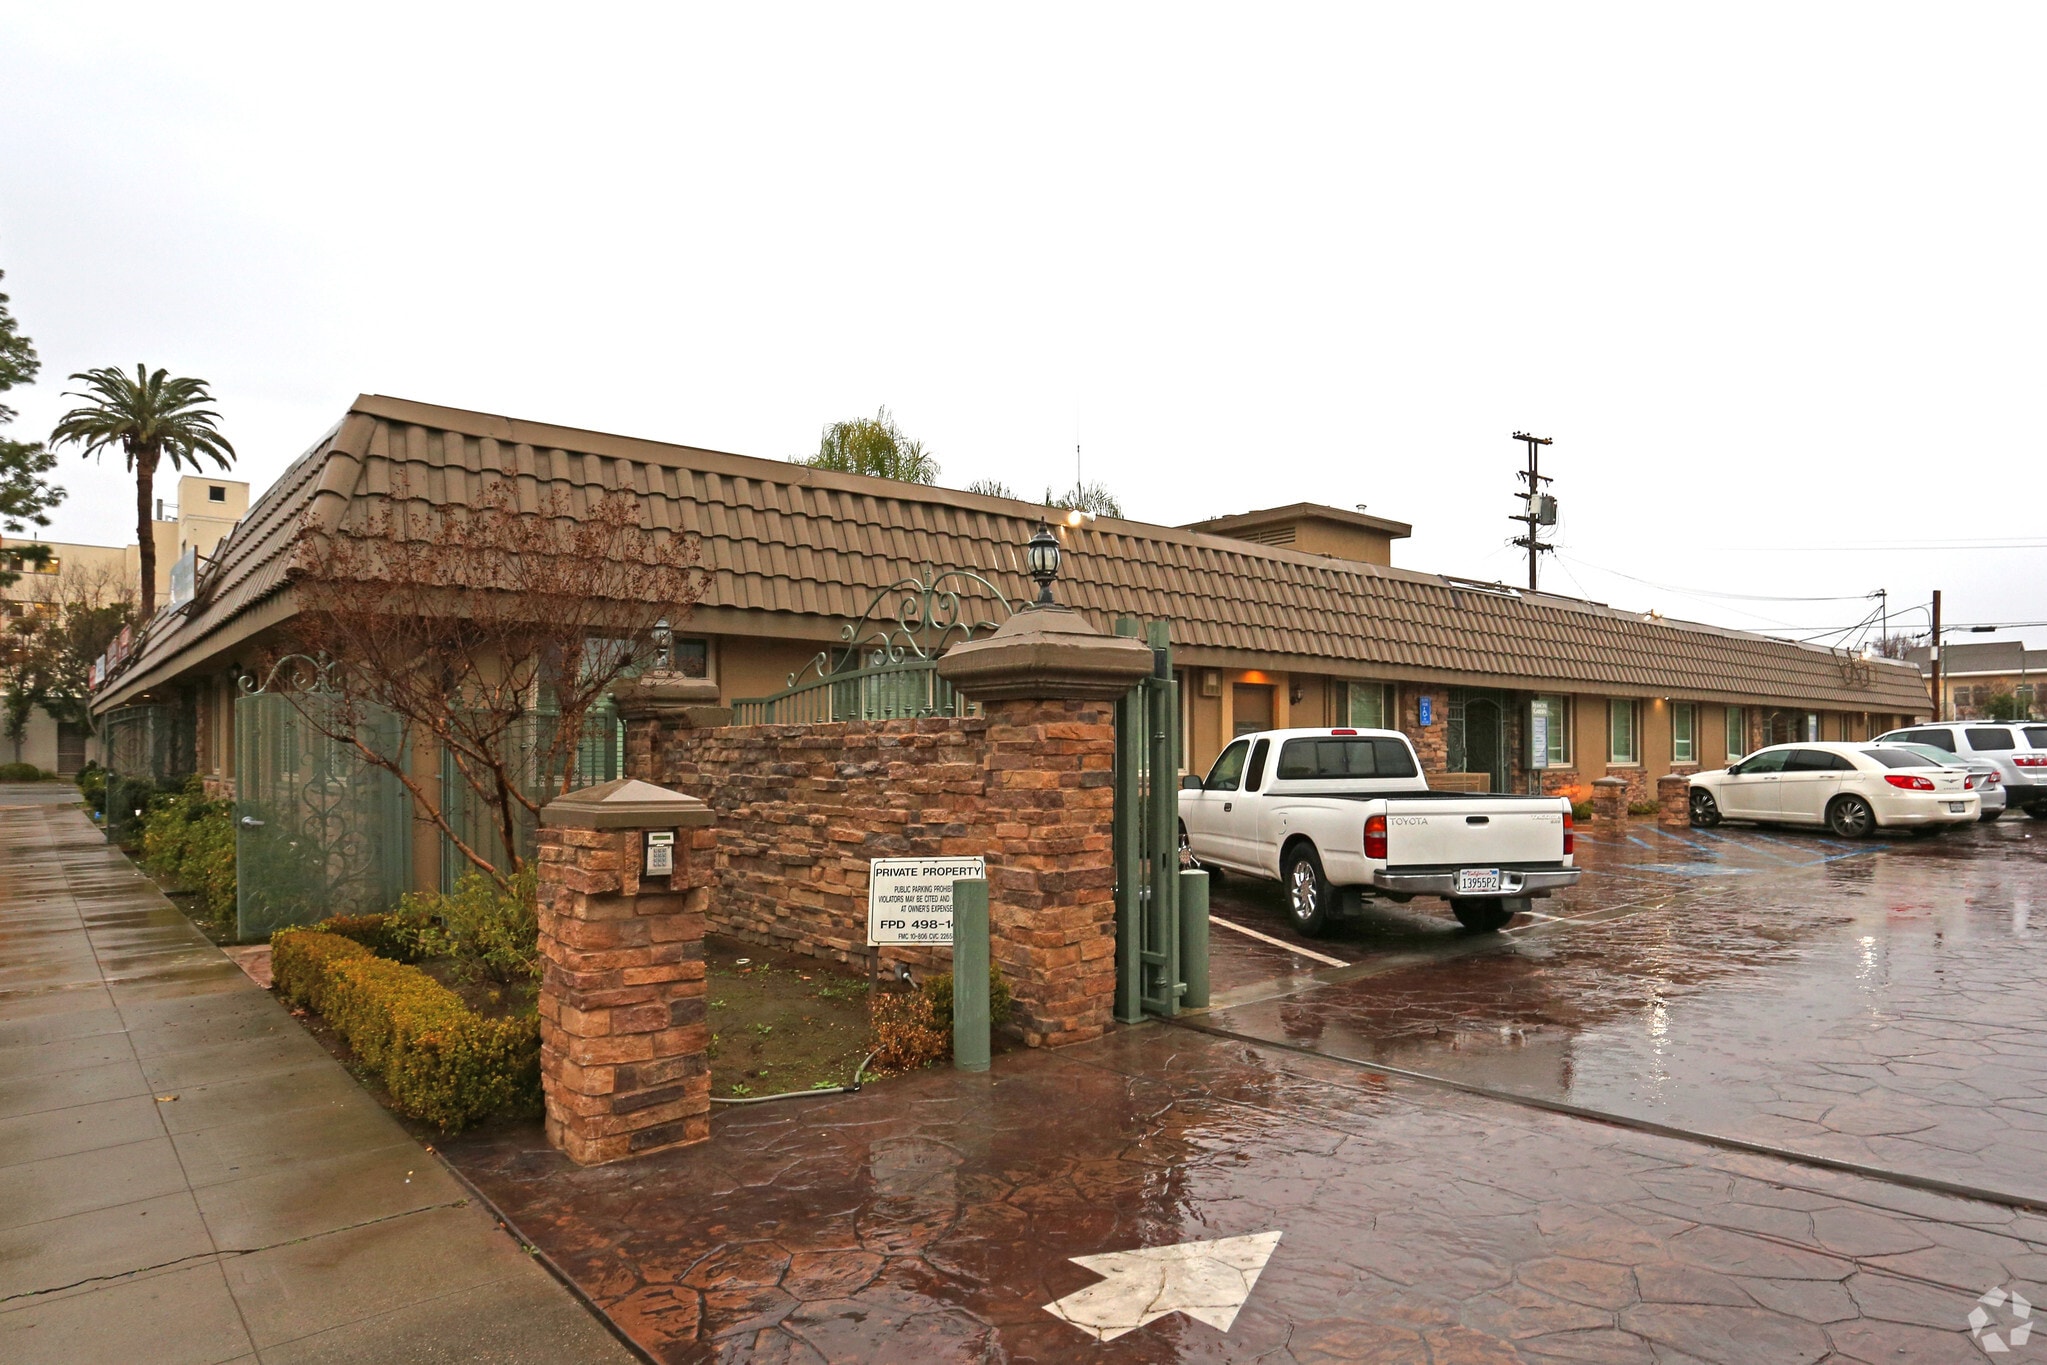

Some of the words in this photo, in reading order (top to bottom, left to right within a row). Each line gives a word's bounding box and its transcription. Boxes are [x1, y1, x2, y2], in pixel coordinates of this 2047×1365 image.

[1389, 817, 1429, 826] TOYOTA
[875, 868, 917, 877] PRIVATE
[923, 867, 981, 876] PROPERTY
[1462, 877, 1497, 889] 13955P2
[894, 885, 911, 893] PUBLIC
[912, 885, 932, 893] PARKING
[933, 885, 953, 893] PROHIBI
[878, 895, 904, 903] VIOLATORS
[905, 895, 915, 903] MAY
[916, 895, 923, 903] BE
[924, 895, 938, 903] CITED
[900, 905, 907, 913] AT
[907, 905, 930, 913] OWNER'S
[880, 920, 906, 929] FPD
[911, 920, 953, 929] 498-1
